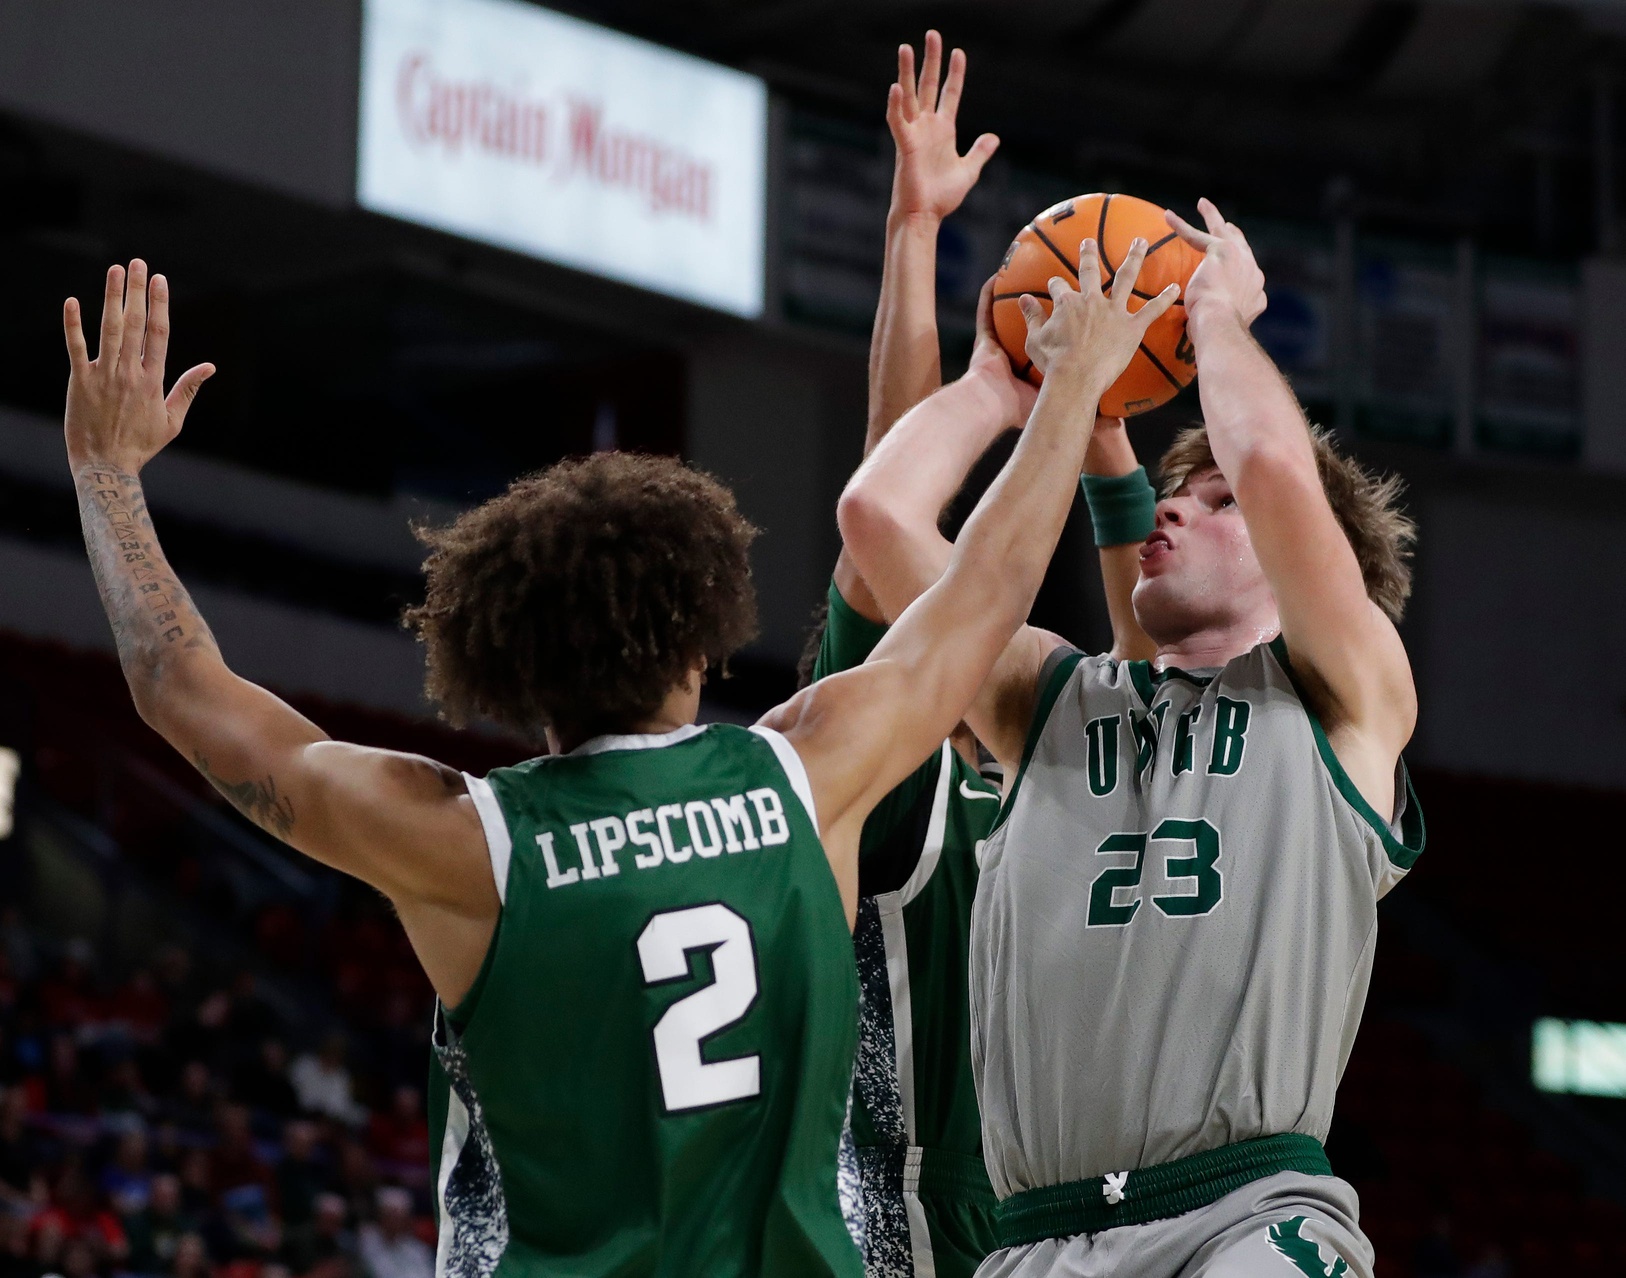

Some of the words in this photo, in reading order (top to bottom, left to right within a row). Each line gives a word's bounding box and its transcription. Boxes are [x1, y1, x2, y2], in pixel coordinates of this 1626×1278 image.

[395, 50, 547, 165] Captain
[551, 94, 715, 224] Morgan
[535, 788, 790, 889] LIPSCOMB
[1085, 817, 1223, 928] 23
[634, 902, 762, 1114] 2
